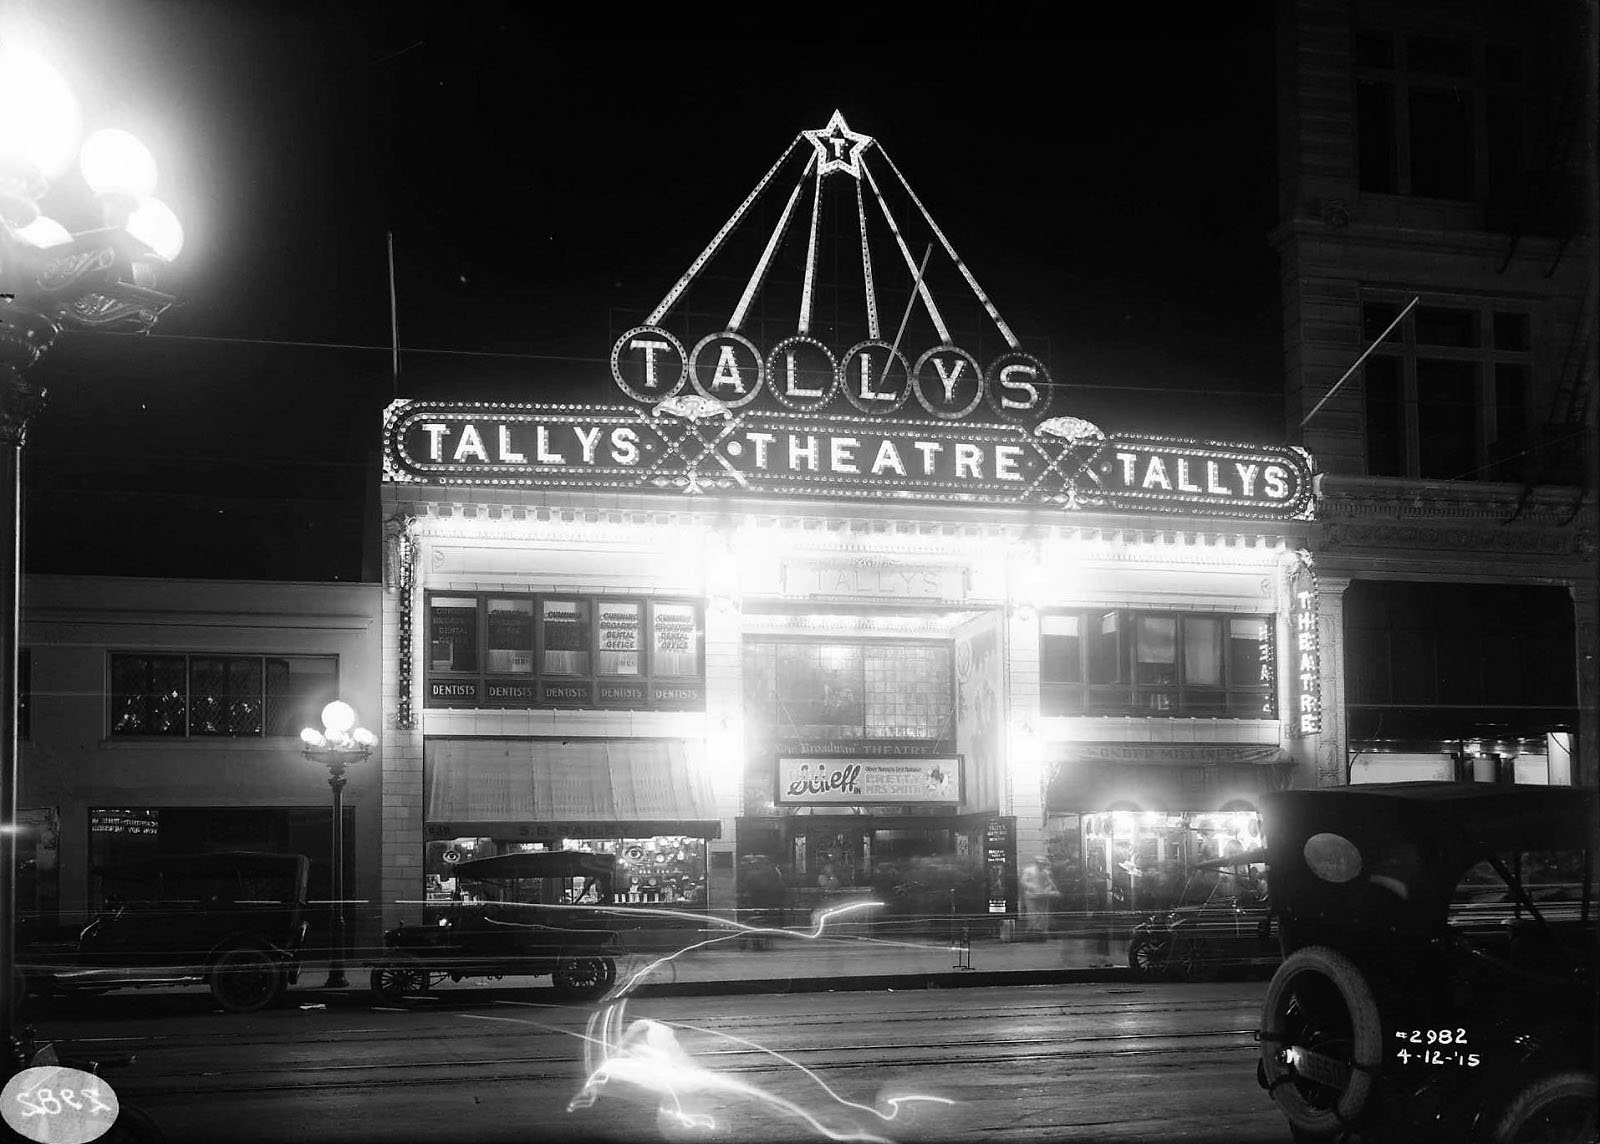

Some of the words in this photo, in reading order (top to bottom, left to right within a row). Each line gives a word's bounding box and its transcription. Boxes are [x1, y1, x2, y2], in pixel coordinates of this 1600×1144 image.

[829, 137, 846, 158] T
[630, 339, 1040, 411] TALLYS
[422, 423, 640, 466] TALLYS
[746, 432, 1026, 482] THEATRE
[1117, 452, 1290, 499] TALLYS
[1298, 591, 1318, 733] THEATRE
[433, 684, 475, 695] DENTISTS
[489, 686, 532, 697] DENTISTS
[546, 687, 588, 698] DENTISTS
[601, 687, 642, 698] DENTISTS
[656, 688, 697, 699] DENTISTS
[863, 745, 929, 755] THEATRE
